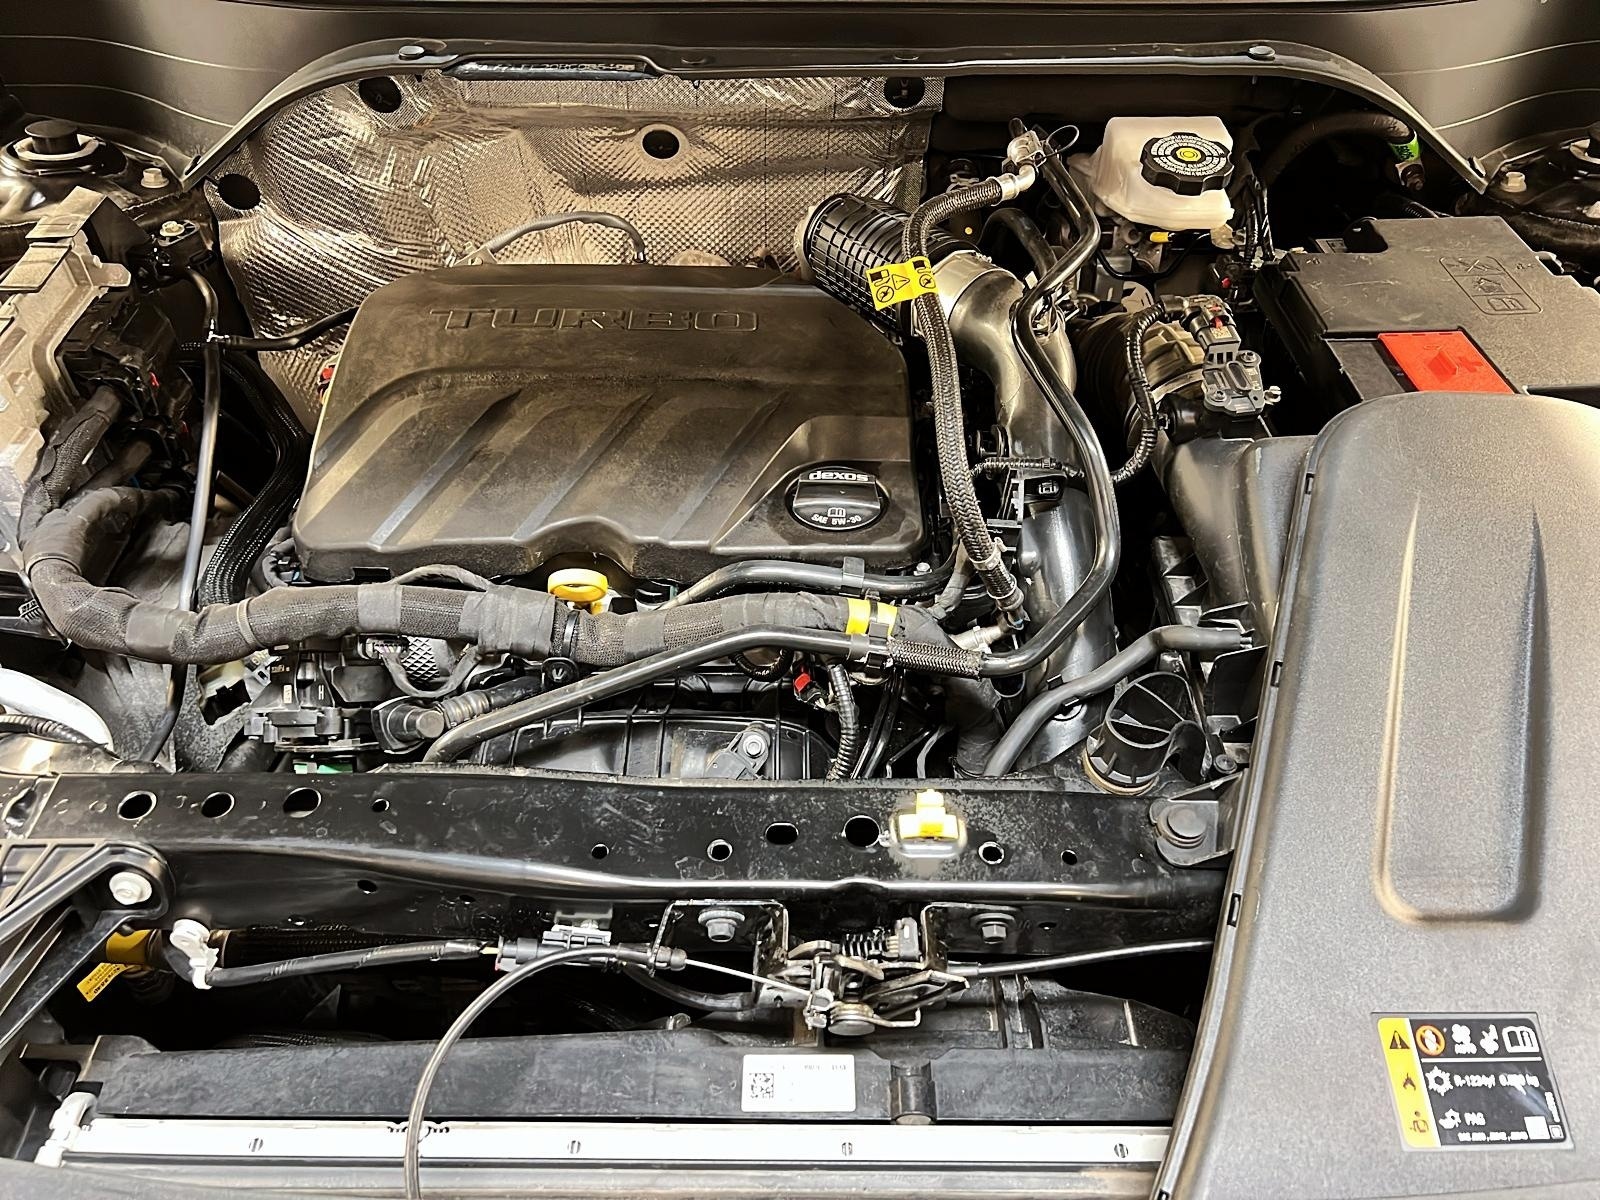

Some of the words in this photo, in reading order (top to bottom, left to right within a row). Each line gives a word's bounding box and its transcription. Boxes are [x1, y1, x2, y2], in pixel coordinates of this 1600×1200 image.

[430, 307, 759, 332] TURBO
[808, 470, 869, 482] dexos
[811, 513, 828, 524] SAE
[831, 515, 862, 526] 5W-30
